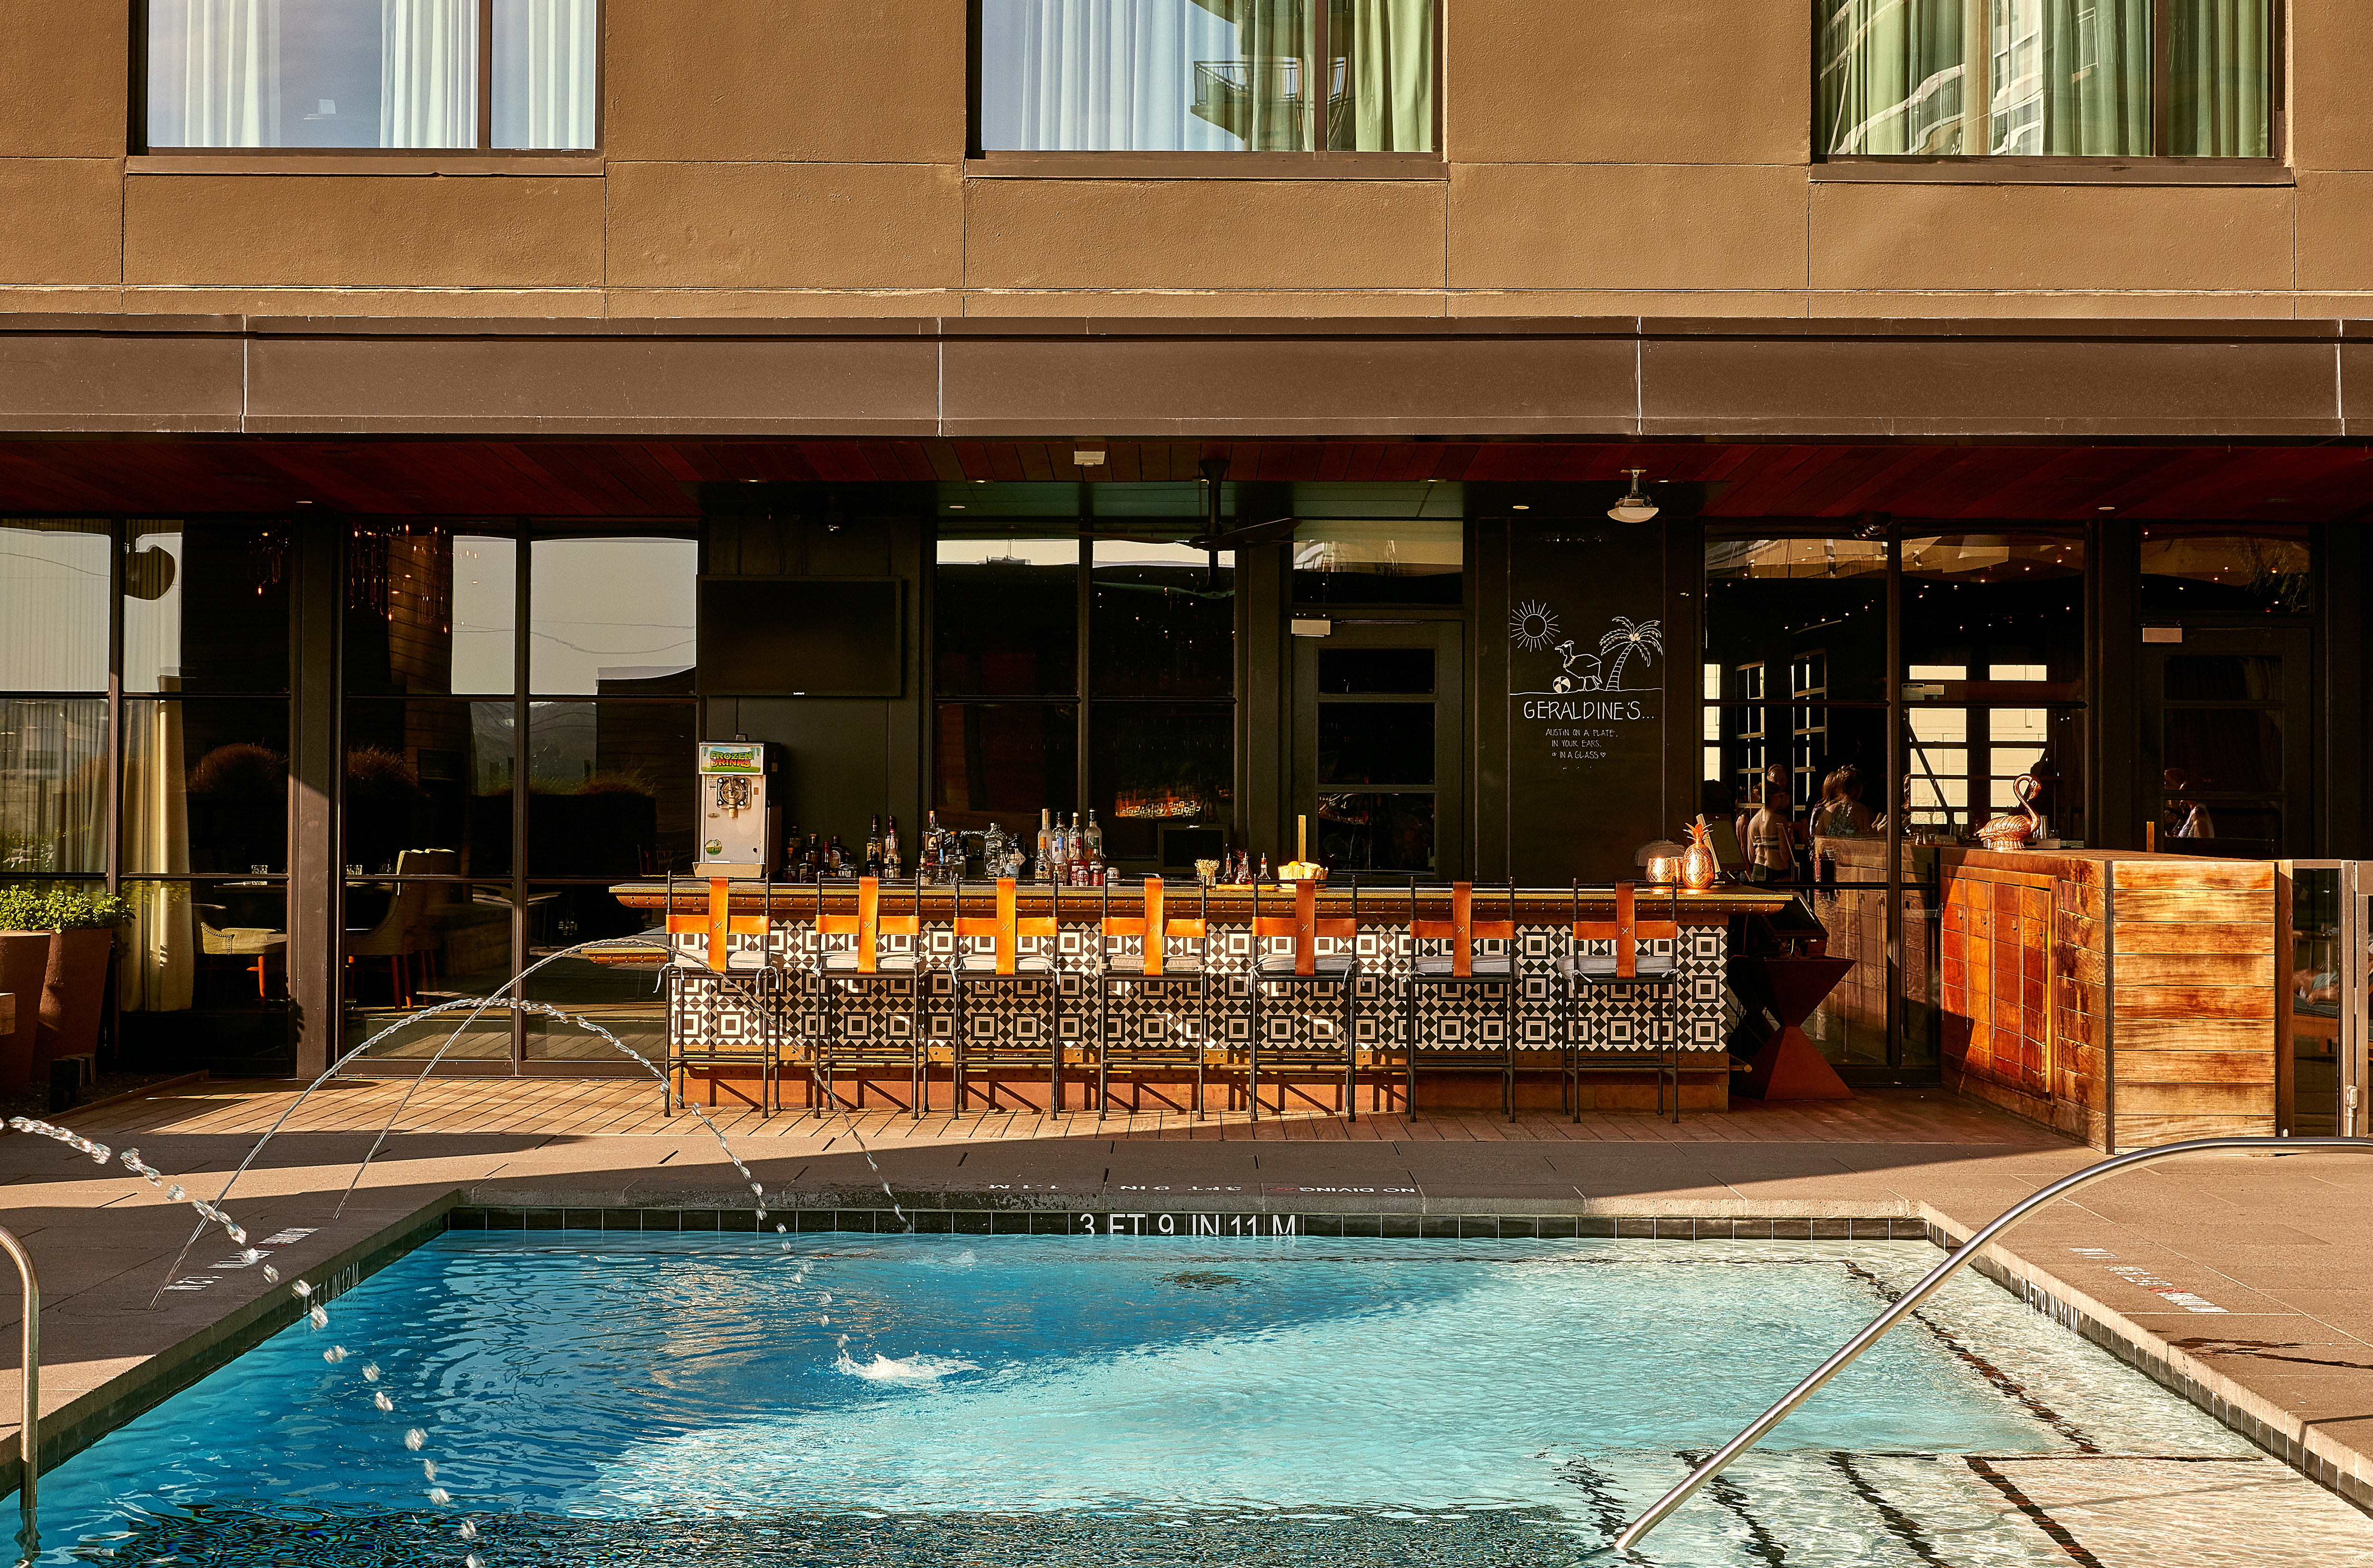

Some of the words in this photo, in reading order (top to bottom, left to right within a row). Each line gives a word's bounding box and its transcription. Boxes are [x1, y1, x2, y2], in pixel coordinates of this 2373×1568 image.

[710, 750, 752, 760] FROZEN
[1575, 751, 1599, 759] GLASS
[710, 759, 751, 768] DRINKS
[1080, 1213, 1095, 1234] 3
[1110, 1213, 1146, 1235] FT
[1158, 1214, 1174, 1234] 9
[1192, 1214, 1219, 1235] IN
[1273, 1215, 1295, 1236] M
[332, 1272, 340, 1299] IN
[352, 1261, 359, 1286] M
[2029, 1281, 2039, 1307] FT
[2049, 1294, 2058, 1317] IN
[2070, 1306, 2078, 1332] M
